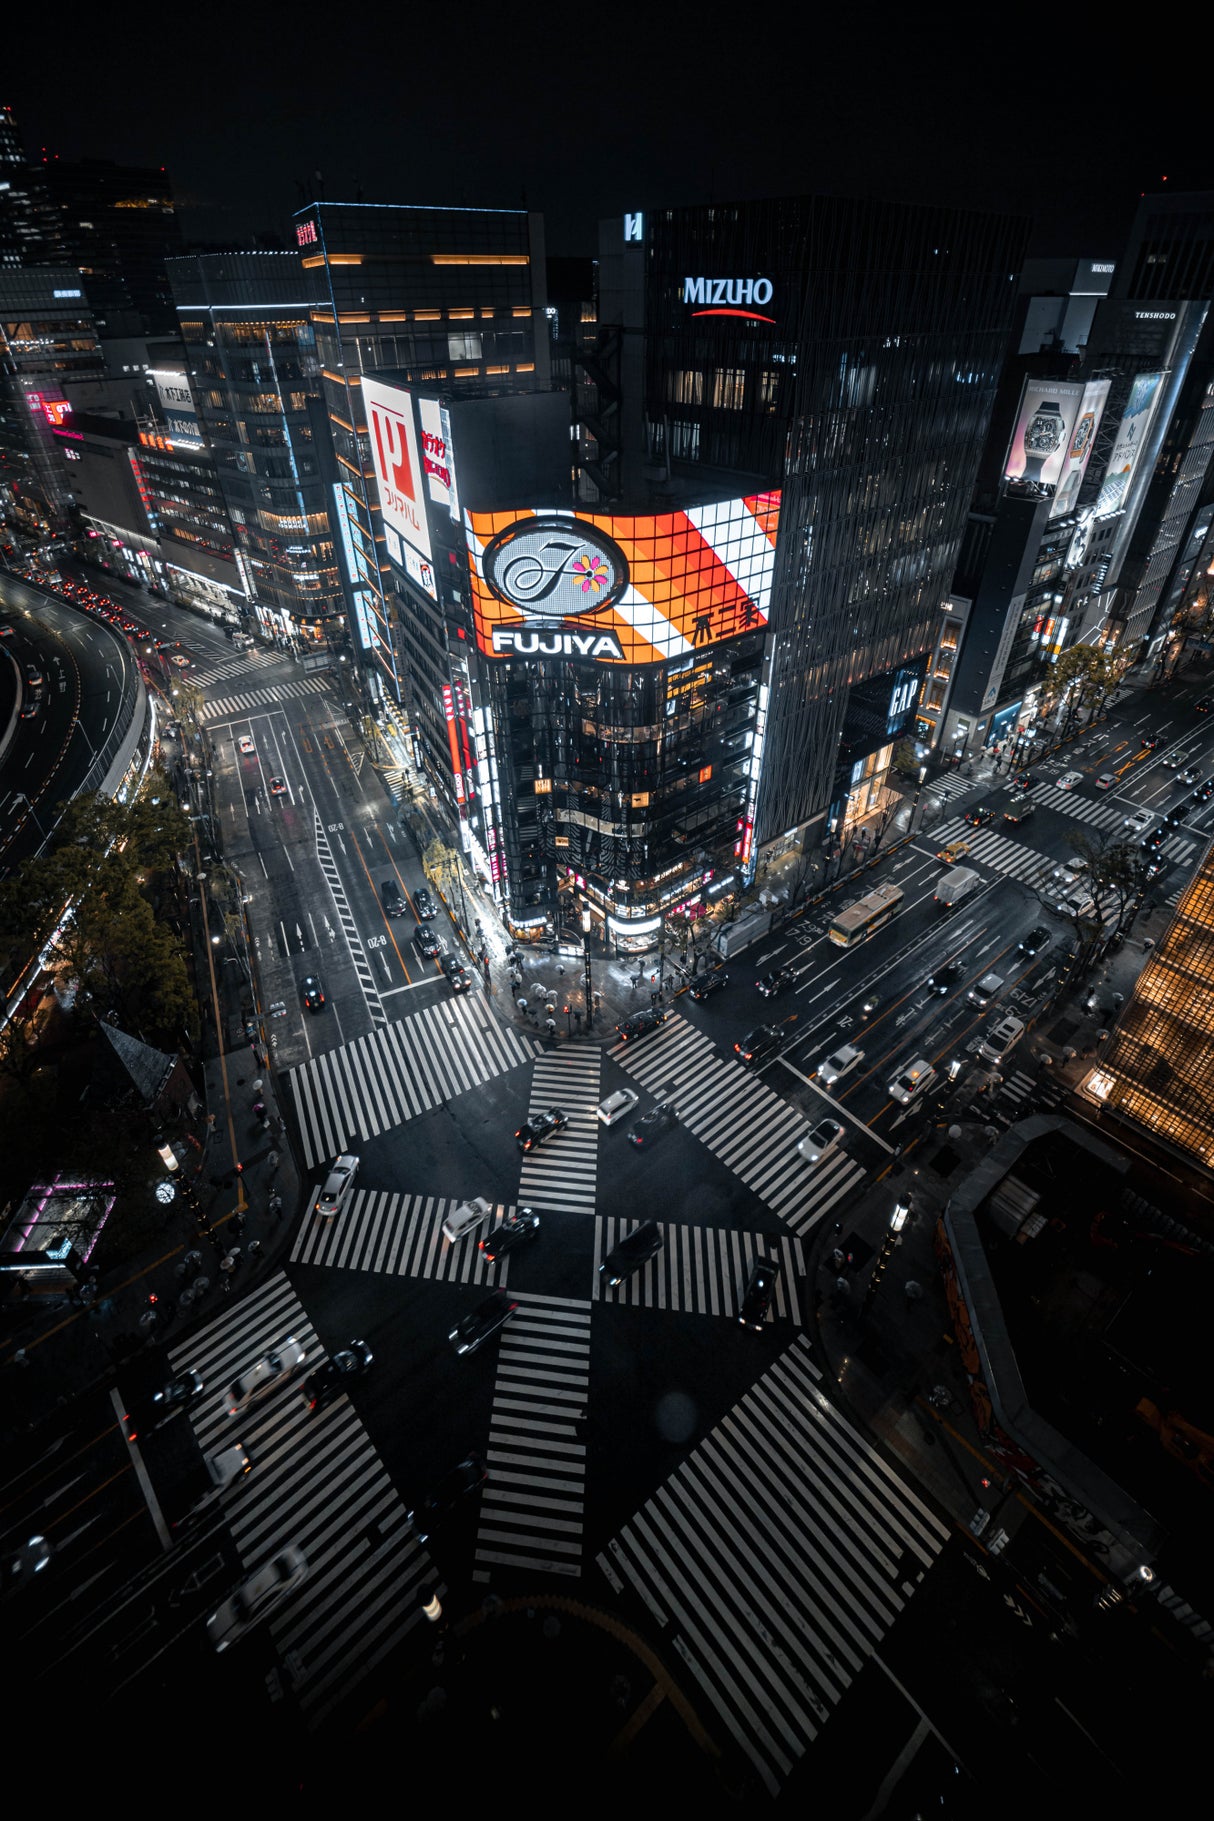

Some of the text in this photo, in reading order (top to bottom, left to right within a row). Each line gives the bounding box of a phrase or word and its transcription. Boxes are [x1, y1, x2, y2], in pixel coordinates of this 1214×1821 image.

[684, 277, 774, 305] MIZUHO
[1135, 311, 1176, 320] TENSHODO
[384, 486, 421, 531] プリマハム
[492, 630, 623, 660] FUJIYA
[888, 678, 919, 717] GAP
[367, 934, 388, 949] 8-20
[784, 927, 813, 946] 17-19
[1009, 987, 1038, 1009] 17-19
